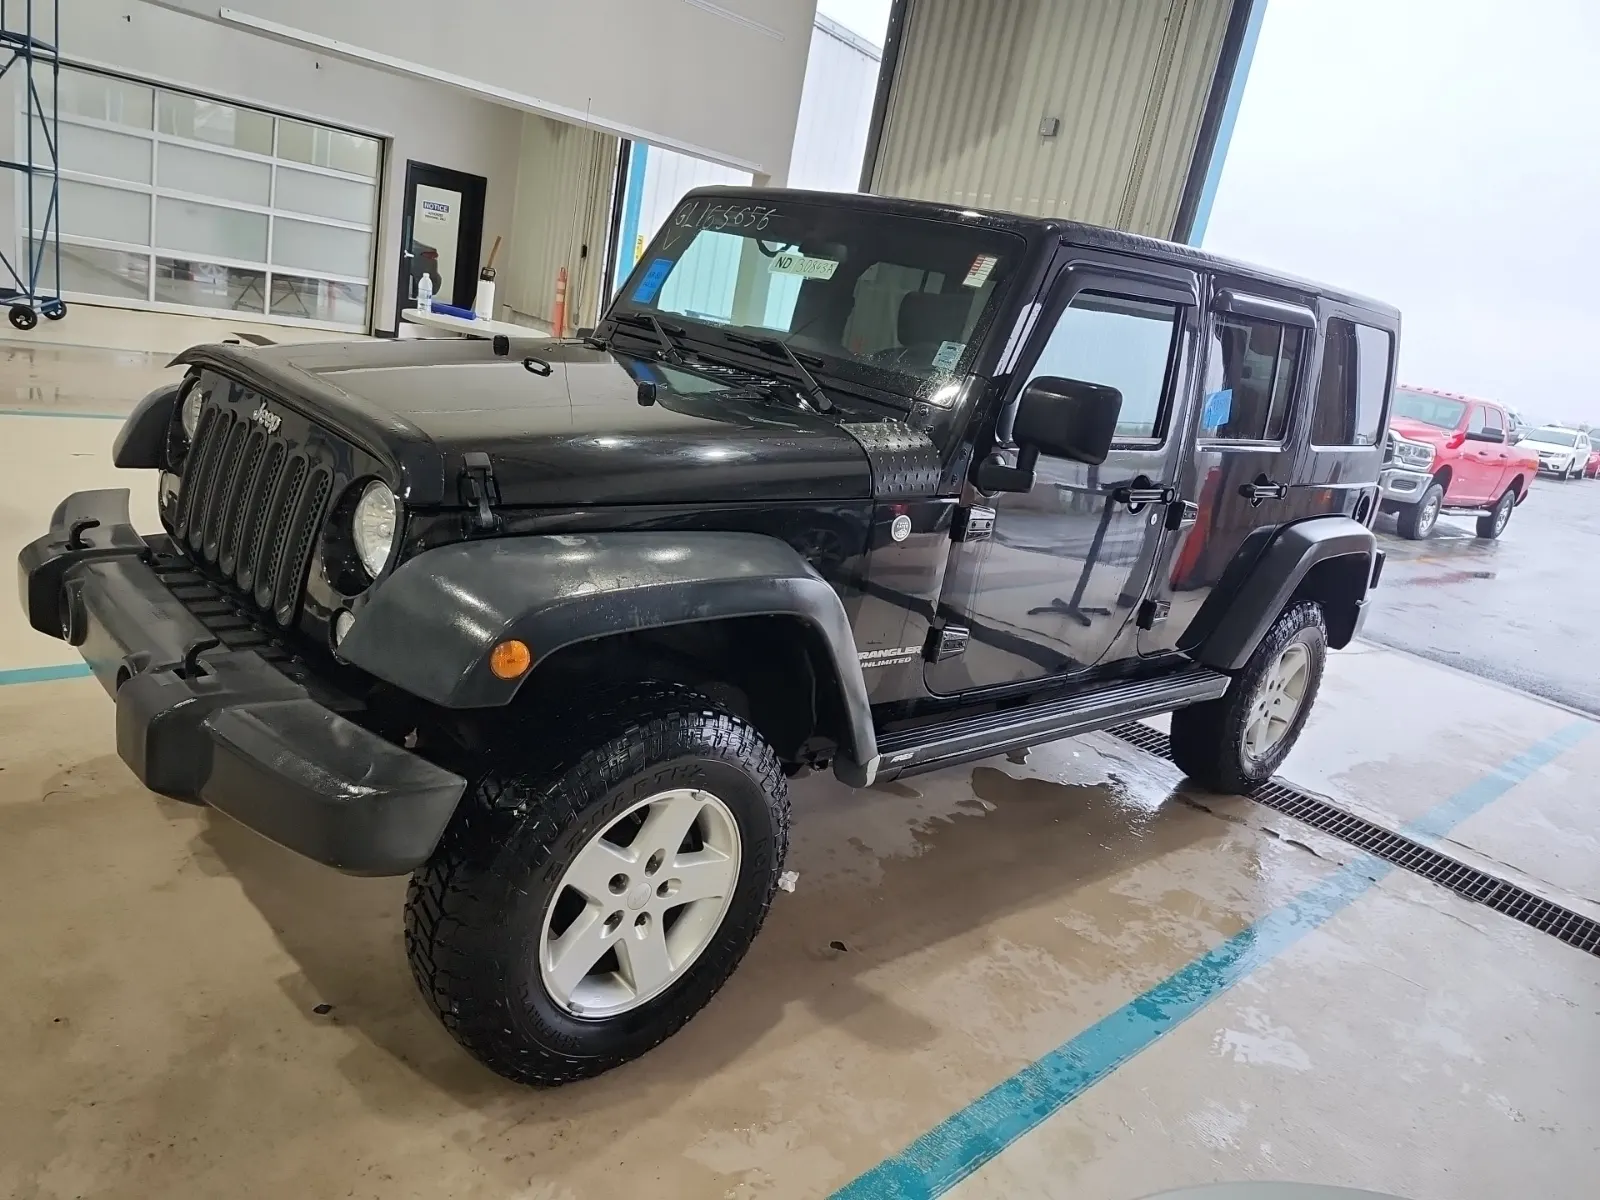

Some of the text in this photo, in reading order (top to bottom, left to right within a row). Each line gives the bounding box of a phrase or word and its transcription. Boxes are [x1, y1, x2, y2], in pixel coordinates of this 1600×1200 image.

[424, 202, 448, 212] NOTICE
[775, 256, 793, 269] ND
[253, 402, 282, 434] Jeep
[858, 645, 922, 660] RANGLER
